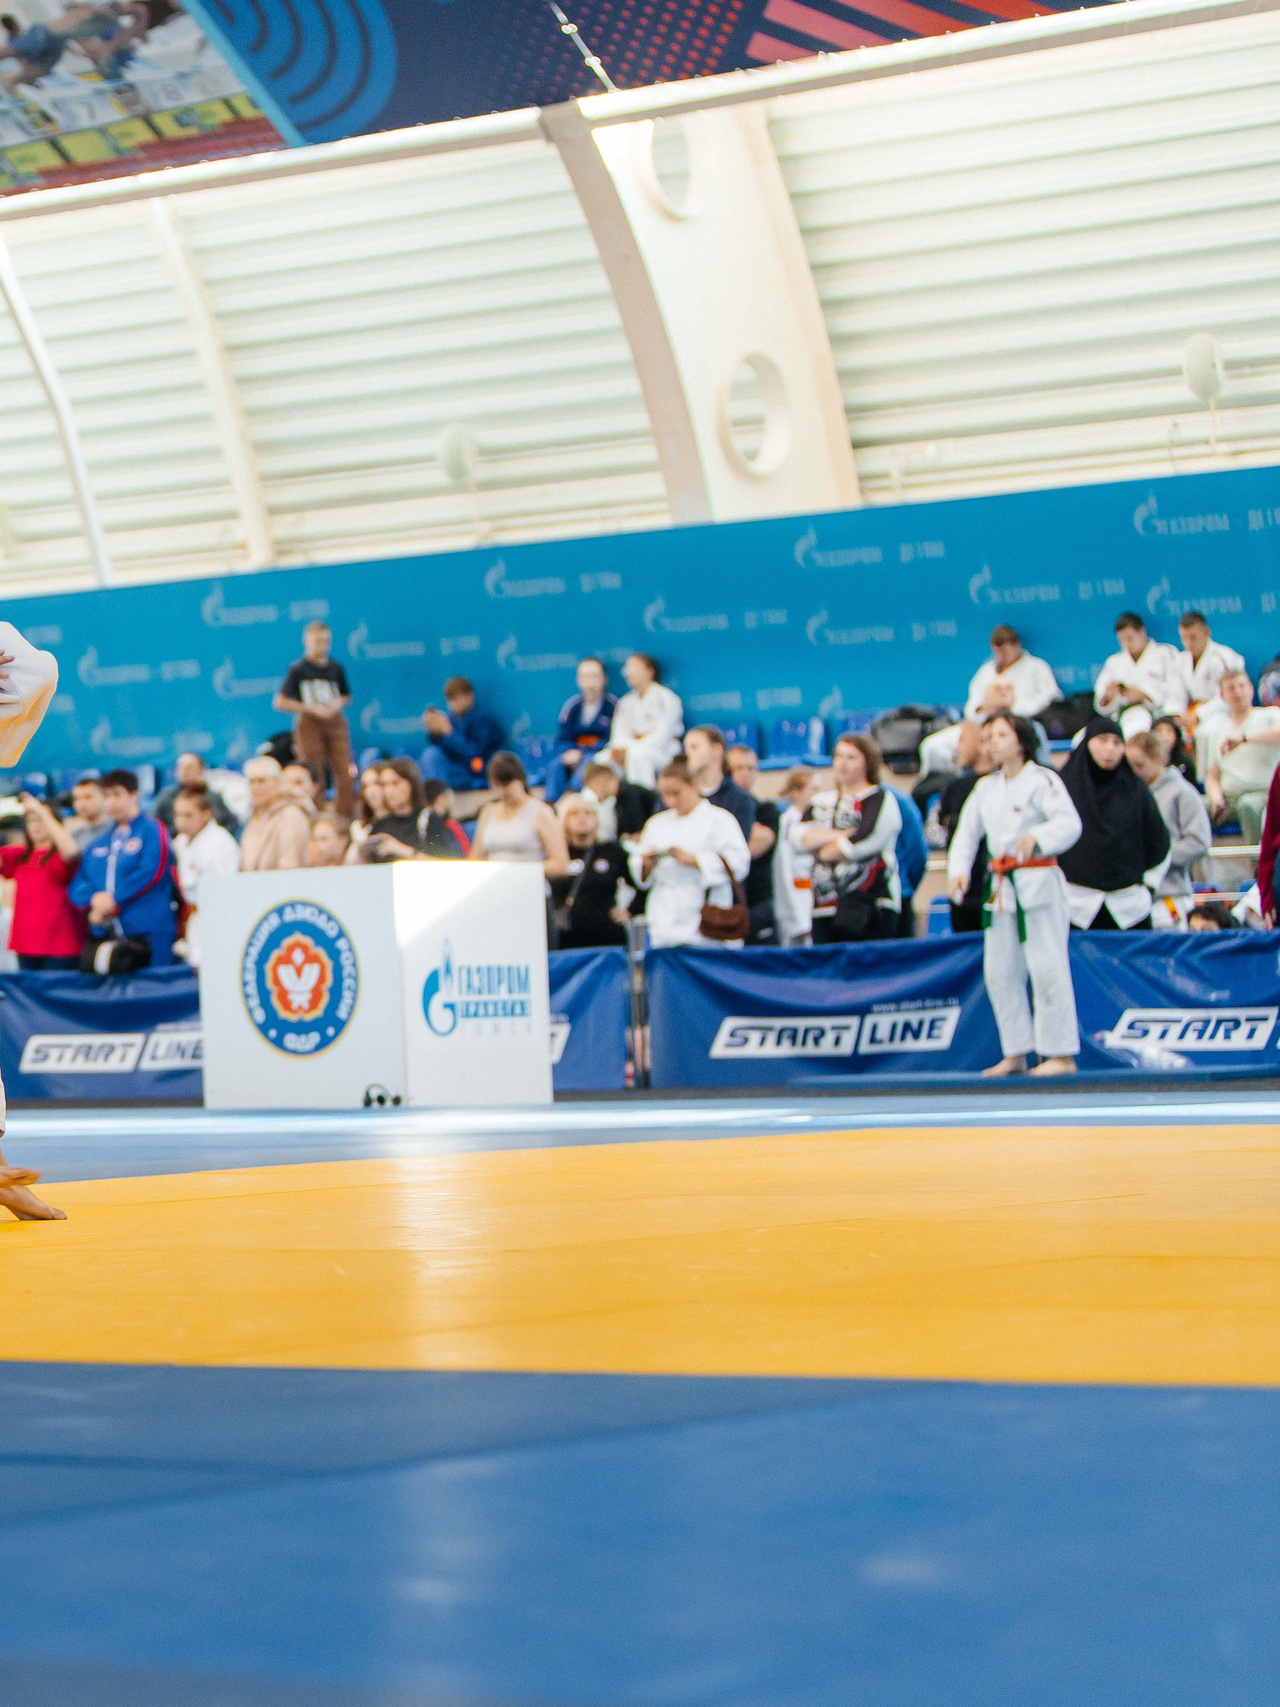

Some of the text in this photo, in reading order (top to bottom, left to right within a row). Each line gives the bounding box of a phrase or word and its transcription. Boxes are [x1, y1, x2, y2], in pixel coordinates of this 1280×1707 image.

[458, 964, 532, 996] ГАЗПРОМ
[724, 1017, 948, 1049] START LINE
[1119, 1015, 1270, 1041] START
[30, 1042, 136, 1065] START
